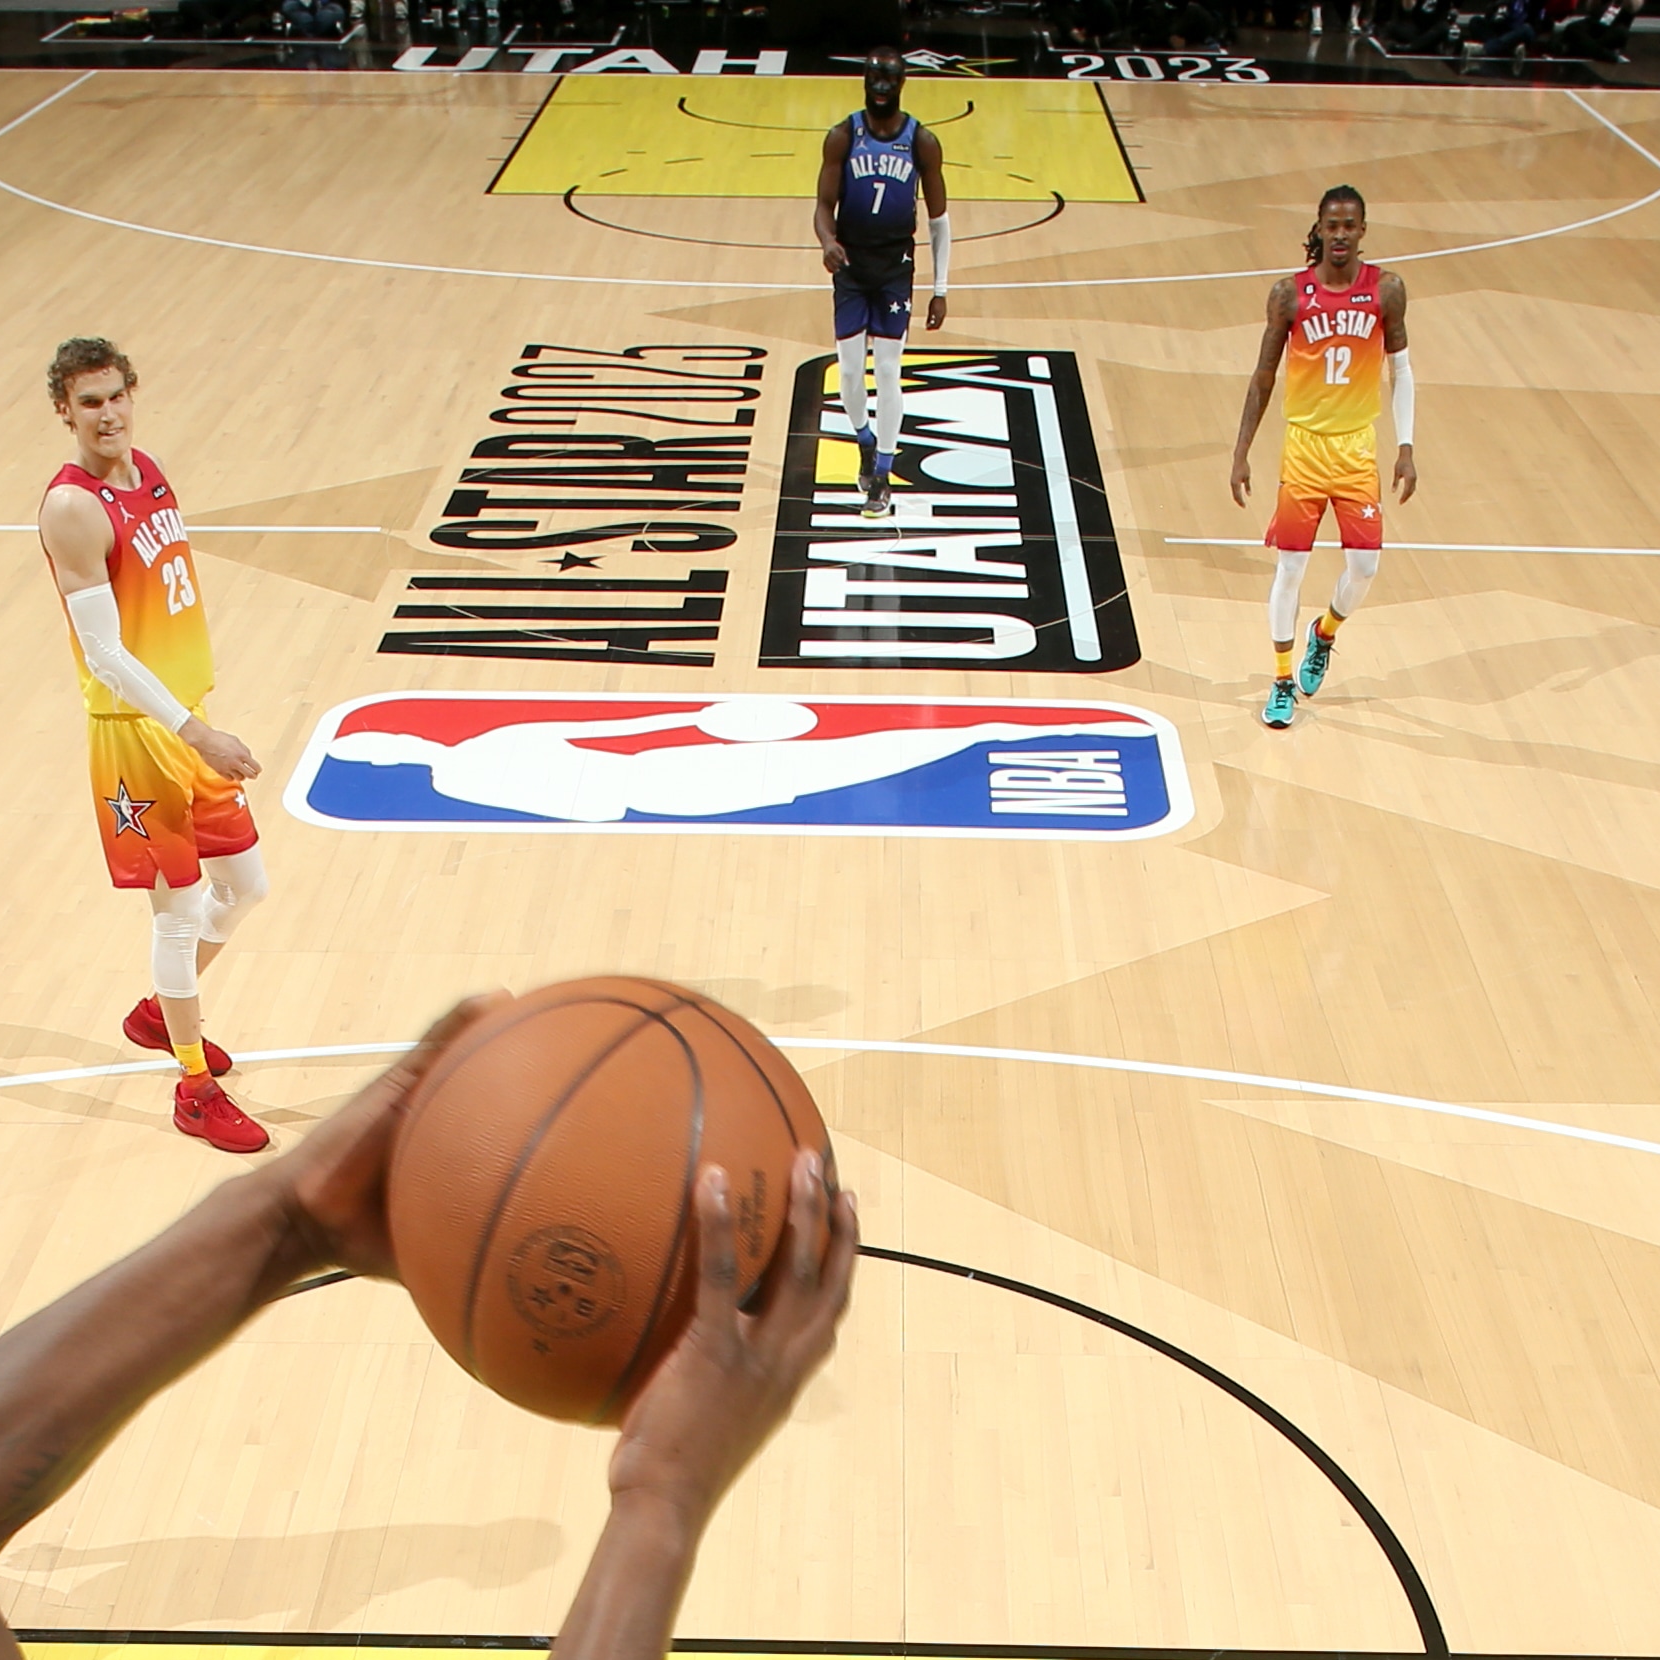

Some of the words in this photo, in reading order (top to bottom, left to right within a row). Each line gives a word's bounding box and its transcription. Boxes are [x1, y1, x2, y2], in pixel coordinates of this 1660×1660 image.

[392, 46, 788, 75] UTAH
[1062, 54, 1270, 83] 2023
[871, 181, 886, 214] 7
[489, 344, 769, 427] 2023
[1324, 346, 1352, 384] 12
[162, 555, 197, 616] 23
[799, 491, 1037, 660] UTAH
[988, 750, 1129, 816] NBA
